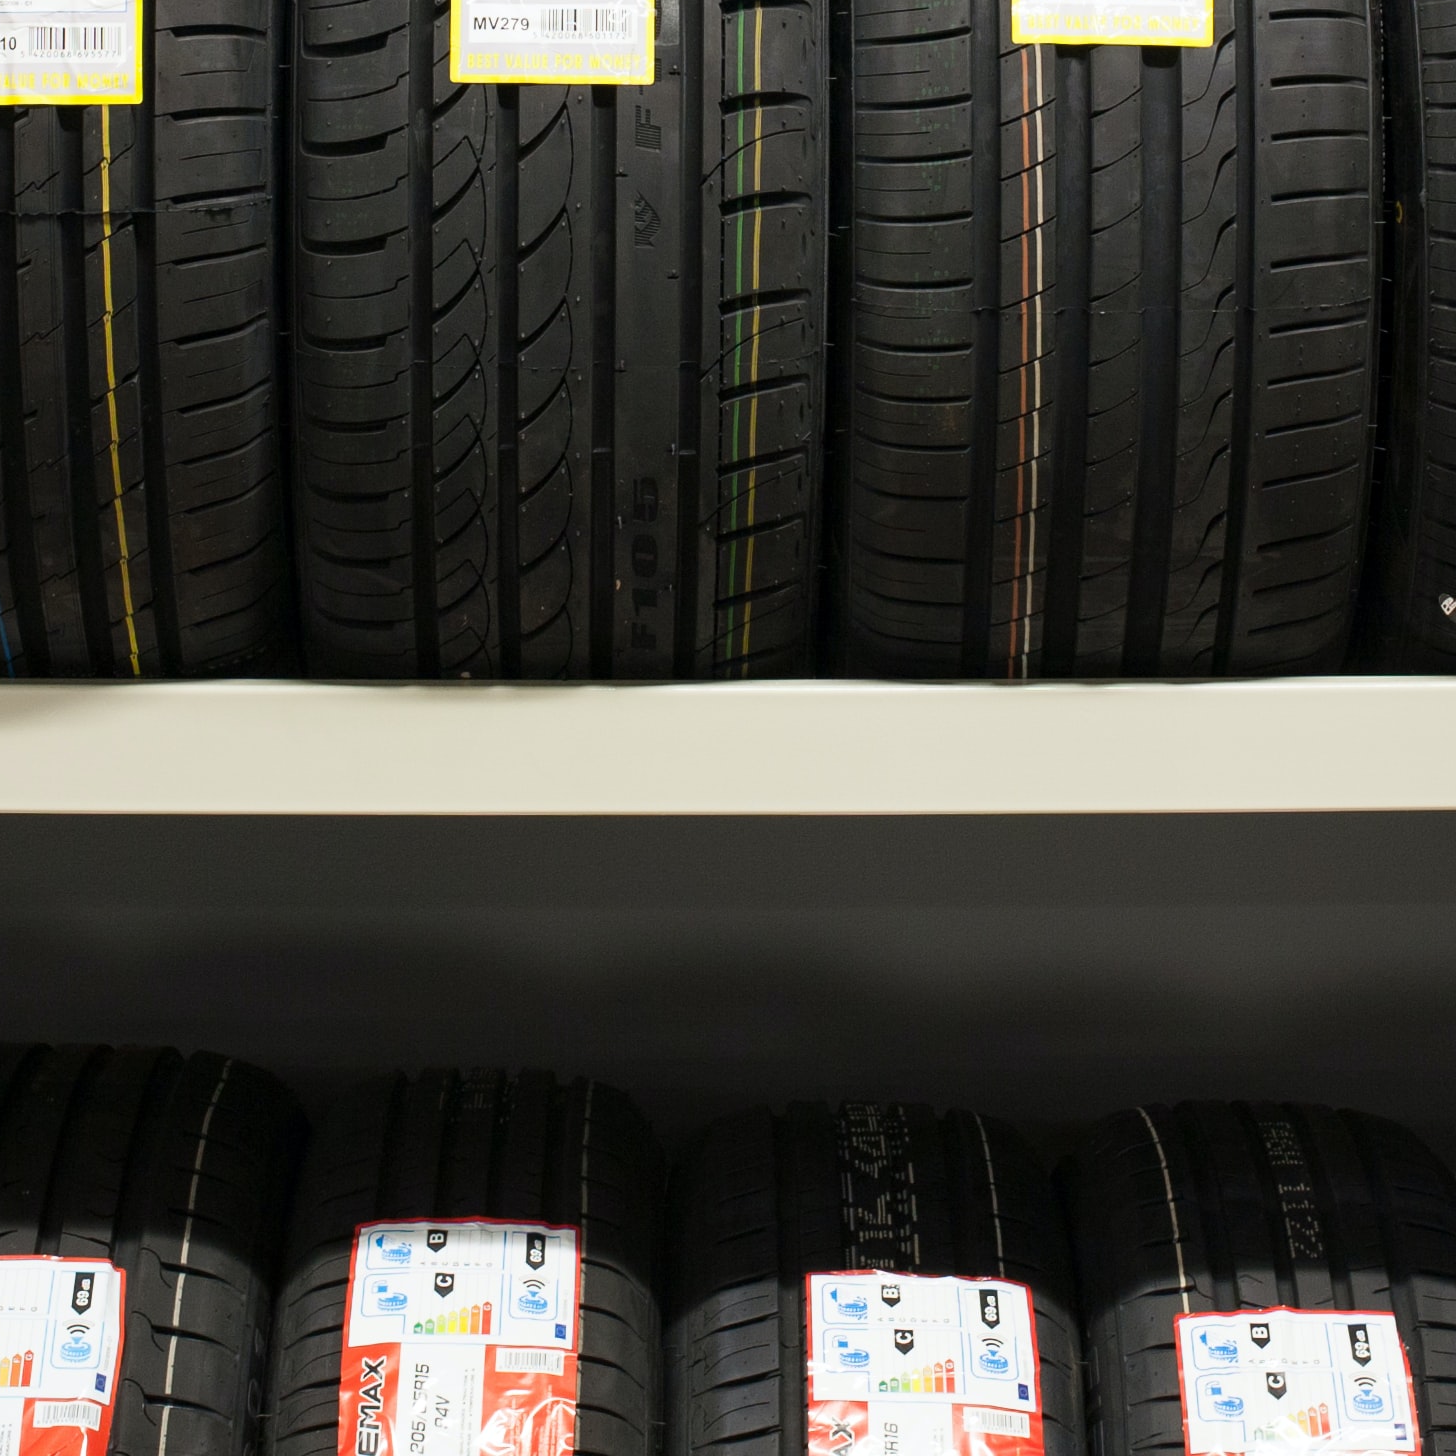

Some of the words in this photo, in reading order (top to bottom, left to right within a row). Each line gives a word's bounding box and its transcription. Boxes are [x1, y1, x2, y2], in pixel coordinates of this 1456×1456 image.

[473, 17, 530, 31] MV279
[429, 1233, 445, 1243] B
[436, 1277, 452, 1287] C
[1251, 1327, 1268, 1339] B
[1267, 1375, 1285, 1388] C
